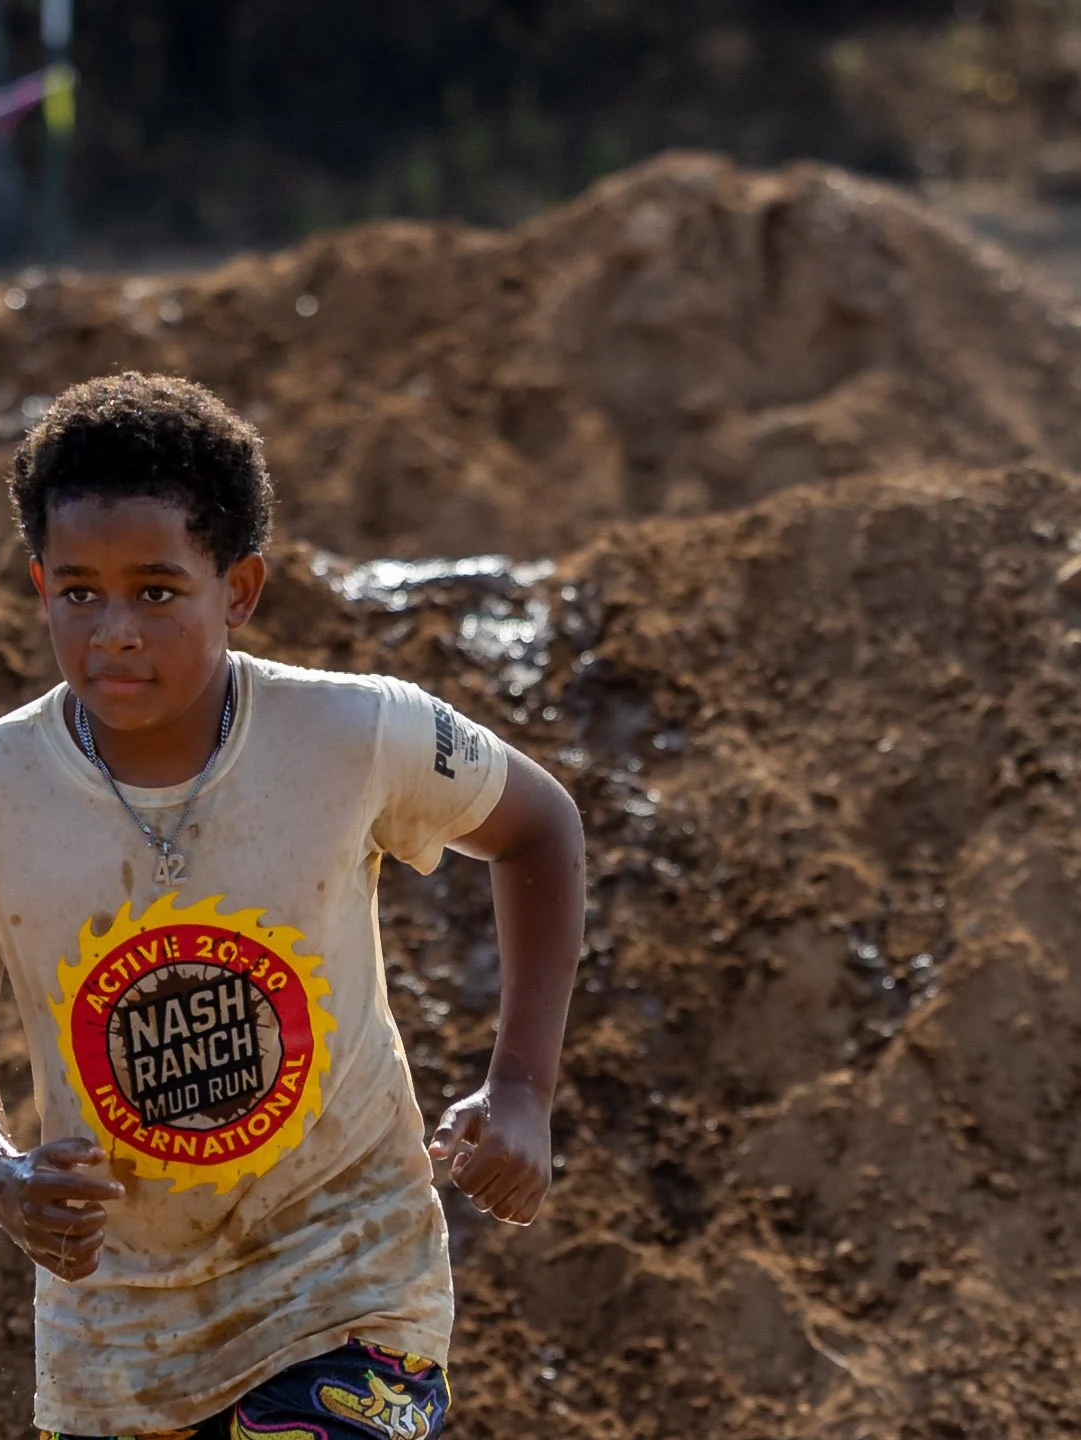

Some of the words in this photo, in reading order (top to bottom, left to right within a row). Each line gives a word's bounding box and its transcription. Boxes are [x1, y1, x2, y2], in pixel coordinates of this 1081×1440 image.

[86, 936, 180, 1014] ACTIVE
[195, 935, 288, 993] 20-30
[129, 978, 245, 1053] NASH
[134, 1023, 253, 1093] RANCH
[145, 1083, 200, 1121] MUD
[208, 1065, 258, 1103] RUN
[95, 1054, 305, 1159] INTERNATIONAL
